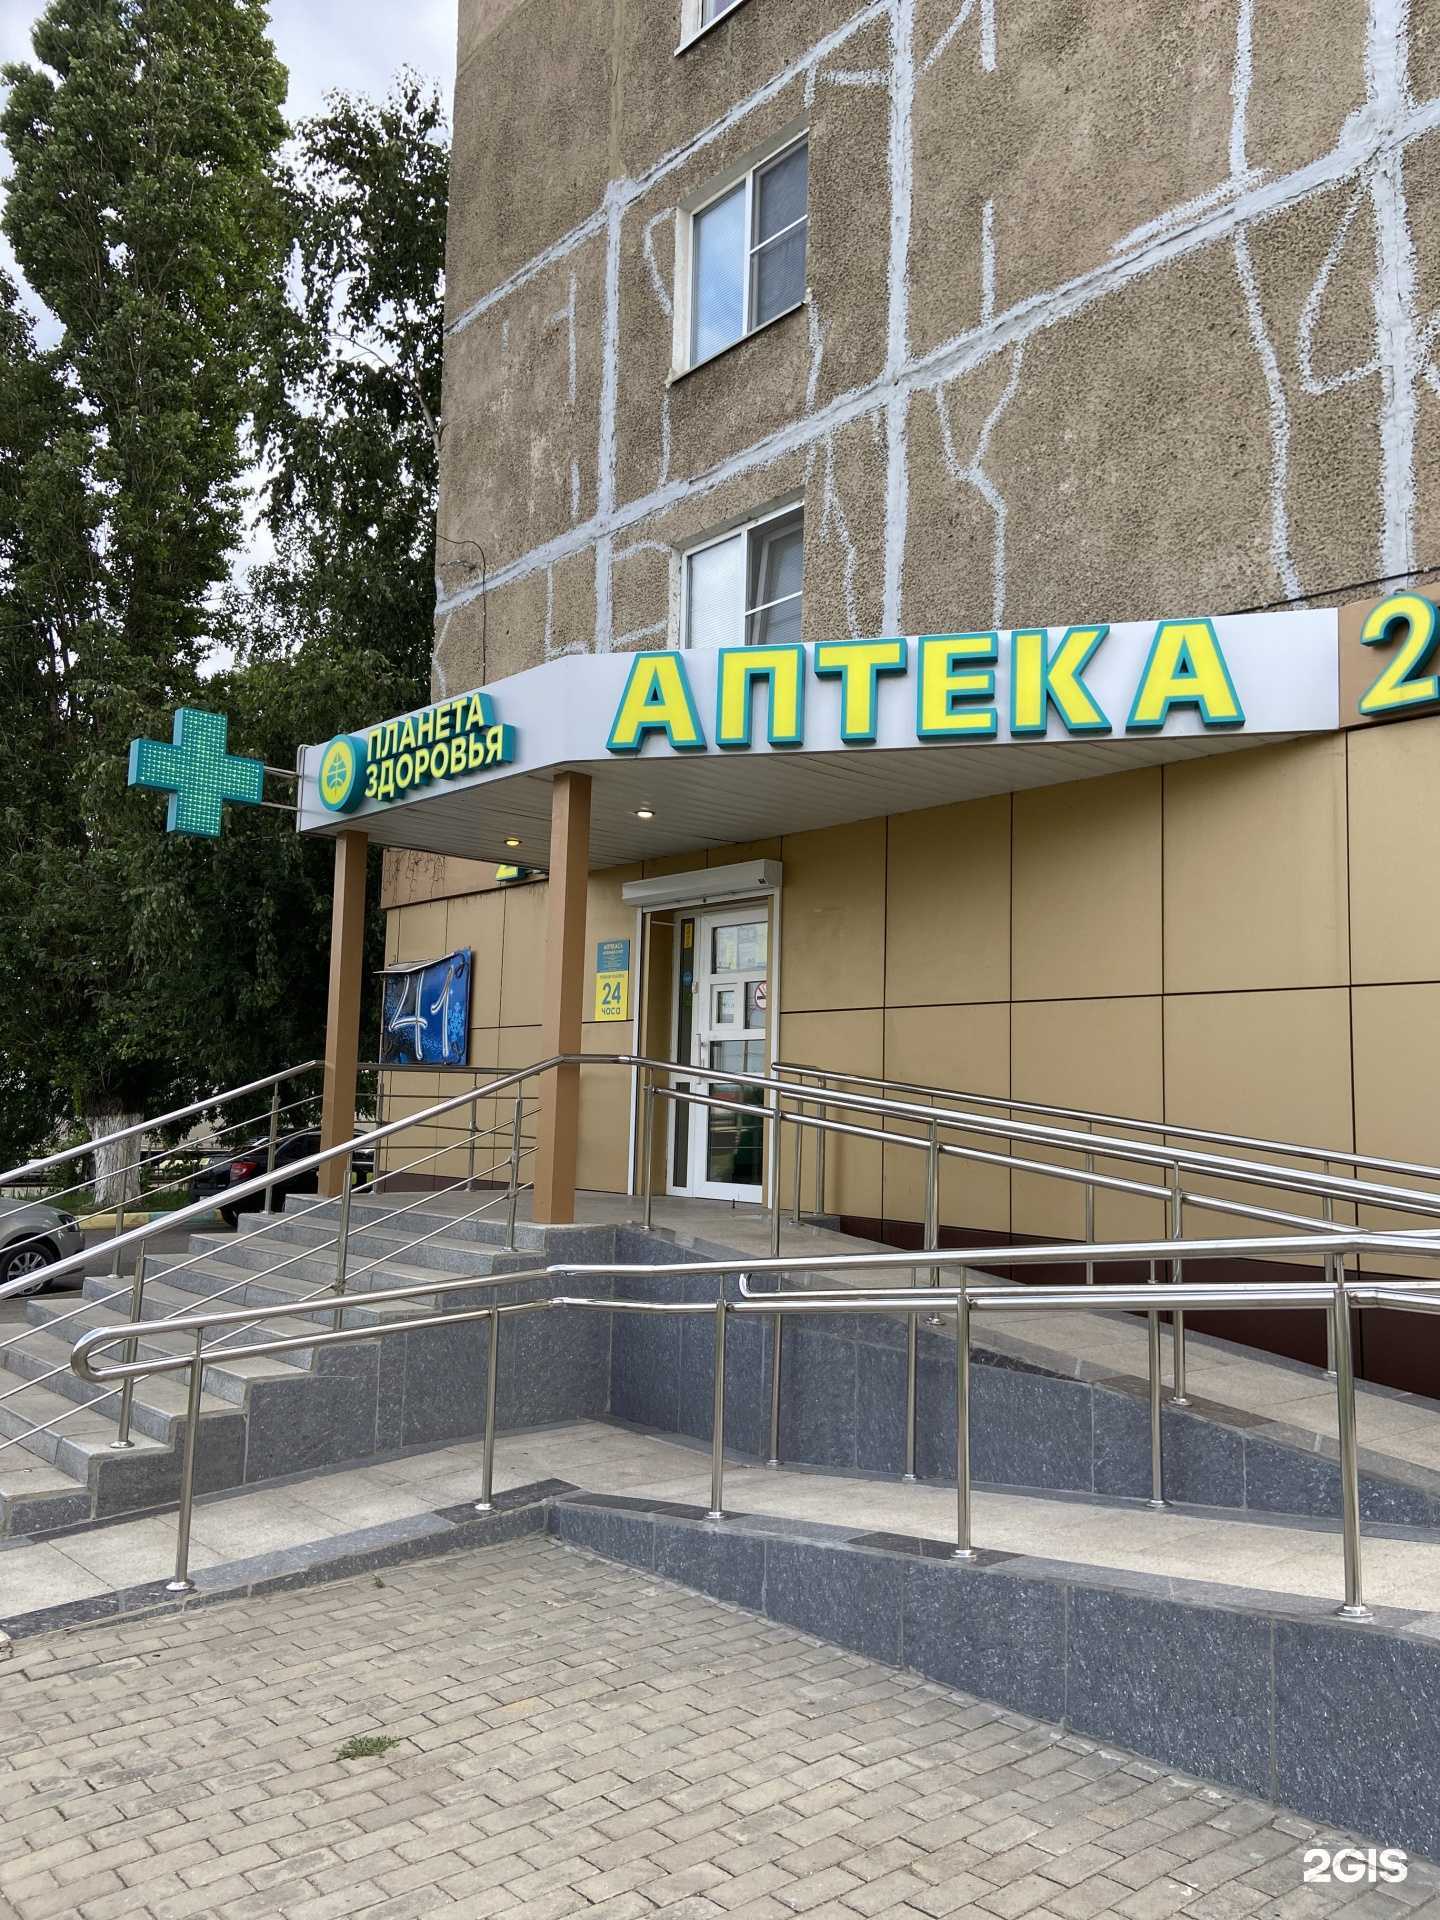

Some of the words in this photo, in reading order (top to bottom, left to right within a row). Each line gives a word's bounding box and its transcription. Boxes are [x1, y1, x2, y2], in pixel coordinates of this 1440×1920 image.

[606, 617, 1246, 752] АПТЕКА
[1359, 592, 1440, 716] 2
[364, 723, 507, 801] ЗДОРОВЬЯ
[366, 692, 491, 762] ПЛАНЕТА
[601, 981, 621, 1005] 24
